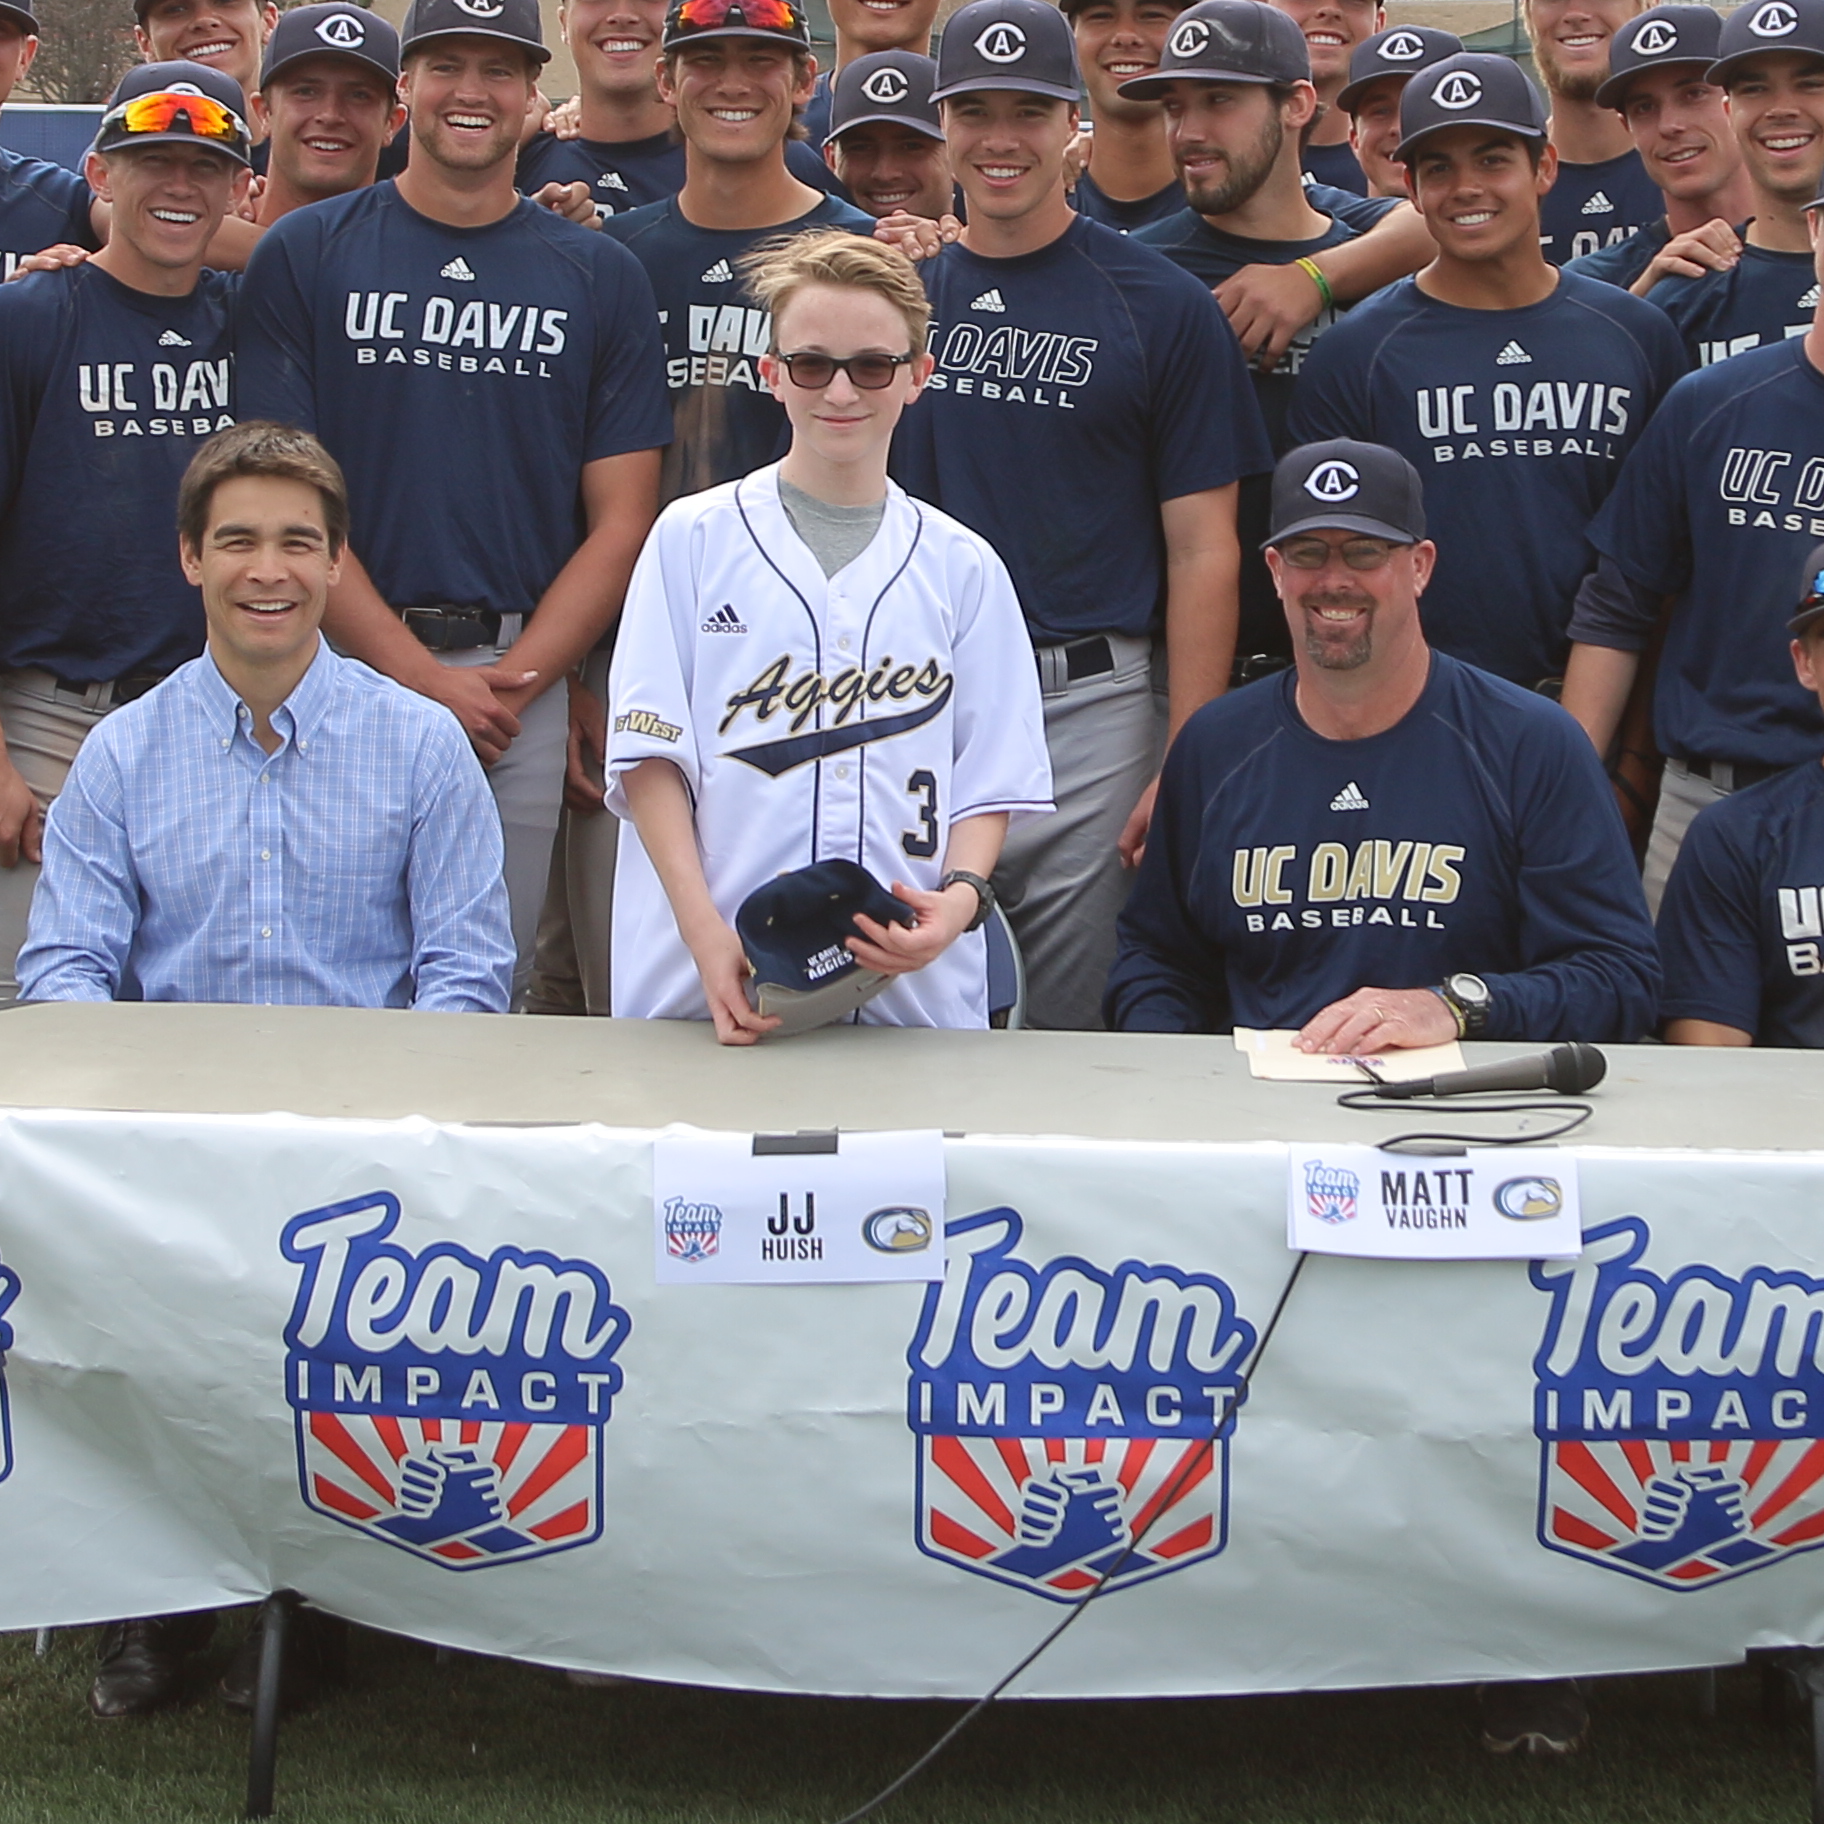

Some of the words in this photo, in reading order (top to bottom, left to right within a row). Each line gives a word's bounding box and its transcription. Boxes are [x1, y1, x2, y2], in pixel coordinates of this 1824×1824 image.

[344, 291, 408, 341] UC
[421, 296, 569, 356] DAVIS
[356, 347, 552, 379] BASEBALL
[939, 322, 1098, 387] DAVIS
[78, 363, 137, 413] UC
[1417, 385, 1477, 439] UC
[1493, 382, 1632, 436] DAVIS
[1434, 437, 1616, 463] BASEBALL
[1719, 448, 1790, 504] UC
[701, 622, 748, 635] adidas
[720, 654, 954, 735] Aggies
[901, 769, 941, 862] 3
[1232, 845, 1297, 908] UC
[1308, 840, 1466, 906] DAVIS
[1246, 907, 1446, 933] BASEBALL
[807, 950, 853, 980] AGGIES
[1303, 1159, 1360, 1187] Team
[1307, 1184, 1358, 1197] IMPACT
[1381, 1169, 1474, 1206] MATT
[664, 1195, 722, 1224] Team
[667, 1222, 719, 1233] IMPACT
[767, 1191, 815, 1236] JJ
[1385, 1207, 1468, 1230] VAUGHN
[762, 1238, 823, 1261] HUISH
[286, 1200, 622, 1360] Team
[918, 1216, 1251, 1375] Team
[297, 1359, 610, 1415] IMPACT
[919, 1381, 1236, 1429] IMPACT
